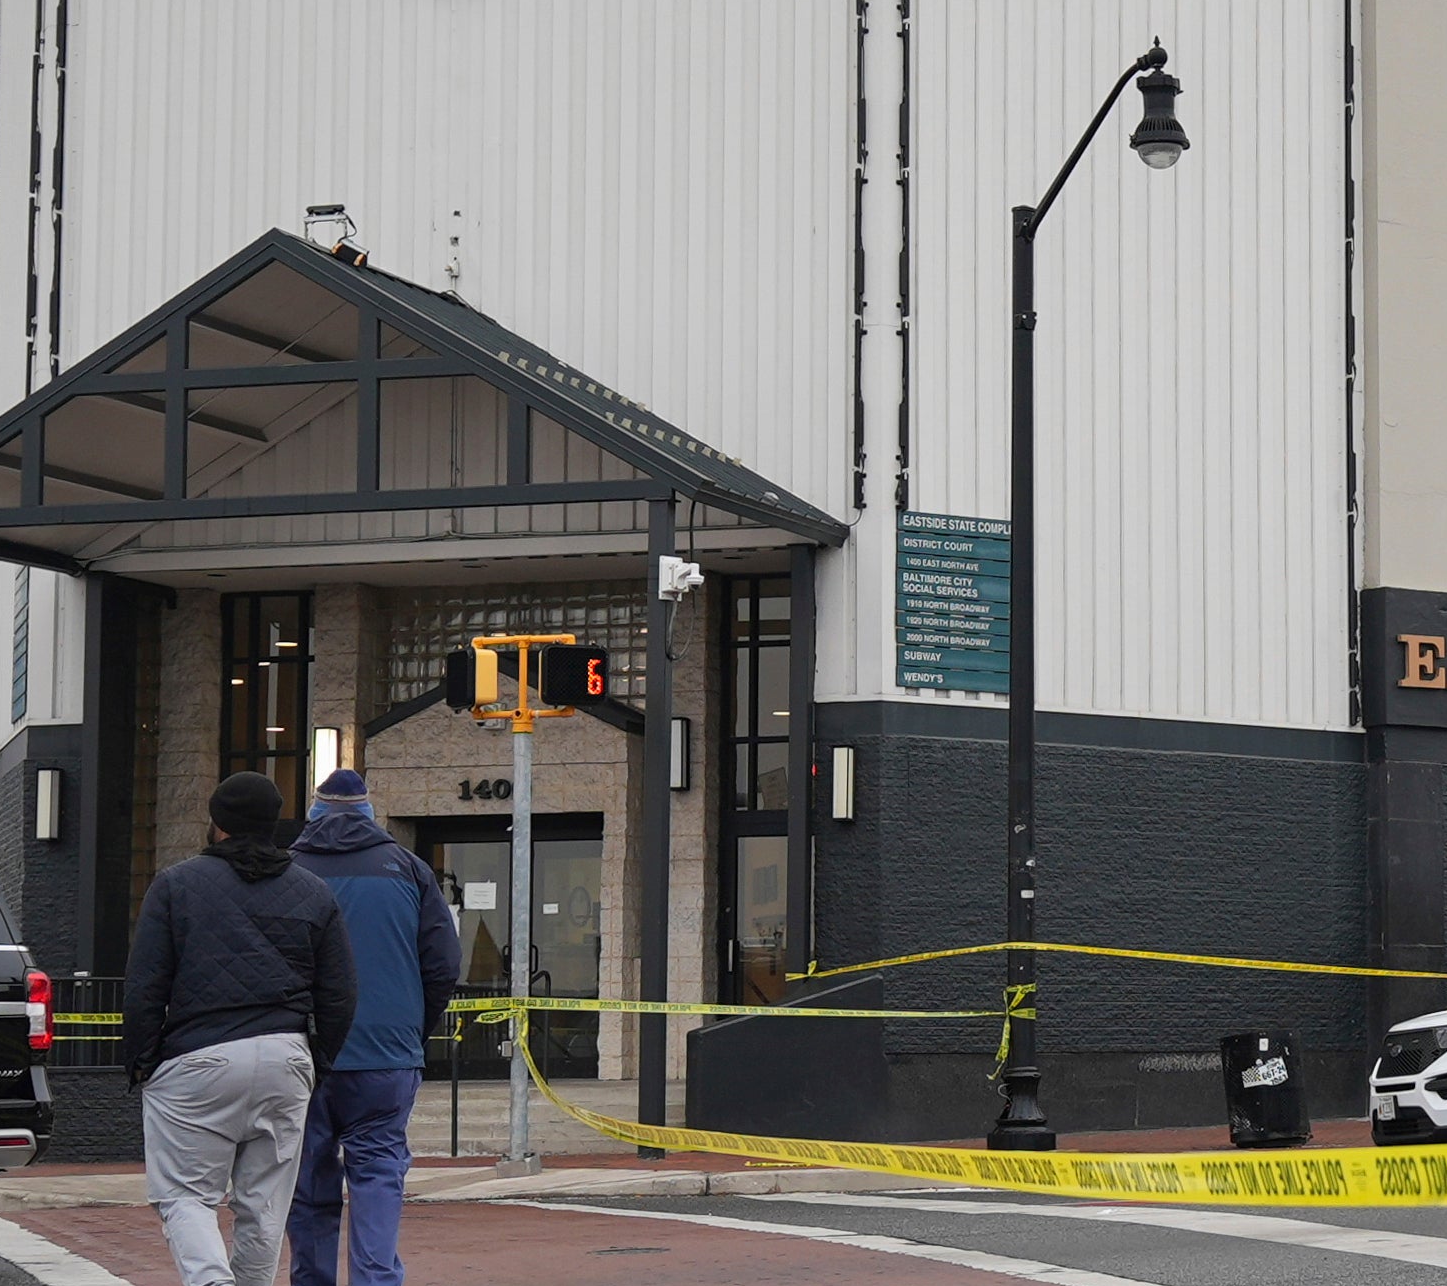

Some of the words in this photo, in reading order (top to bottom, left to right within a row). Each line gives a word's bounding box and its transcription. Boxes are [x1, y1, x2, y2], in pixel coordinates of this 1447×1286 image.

[902, 515, 947, 530] EASTSIDE
[948, 519, 976, 532] STATE
[977, 521, 1011, 535] COMPL
[903, 538, 942, 550] DISTRICT
[943, 541, 974, 552] COURT
[922, 559, 940, 568] EAST
[941, 560, 965, 571] NORTH
[902, 572, 953, 586] BALTIMORE
[953, 577, 973, 587] CITY
[902, 582, 935, 595] SOCIAL
[936, 585, 978, 598] SERVICES
[923, 601, 948, 611] NORTH
[949, 602, 990, 614] BROADWAY
[923, 617, 948, 628] NORTH
[949, 619, 990, 631] BROADWAY
[923, 634, 949, 644] NORTH
[950, 636, 991, 647] BROADWAY
[903, 650, 942, 662] SUBWAY
[587, 658, 602, 695] 6
[903, 671, 944, 684] WENDY'S
[457, 778, 514, 800] 140
